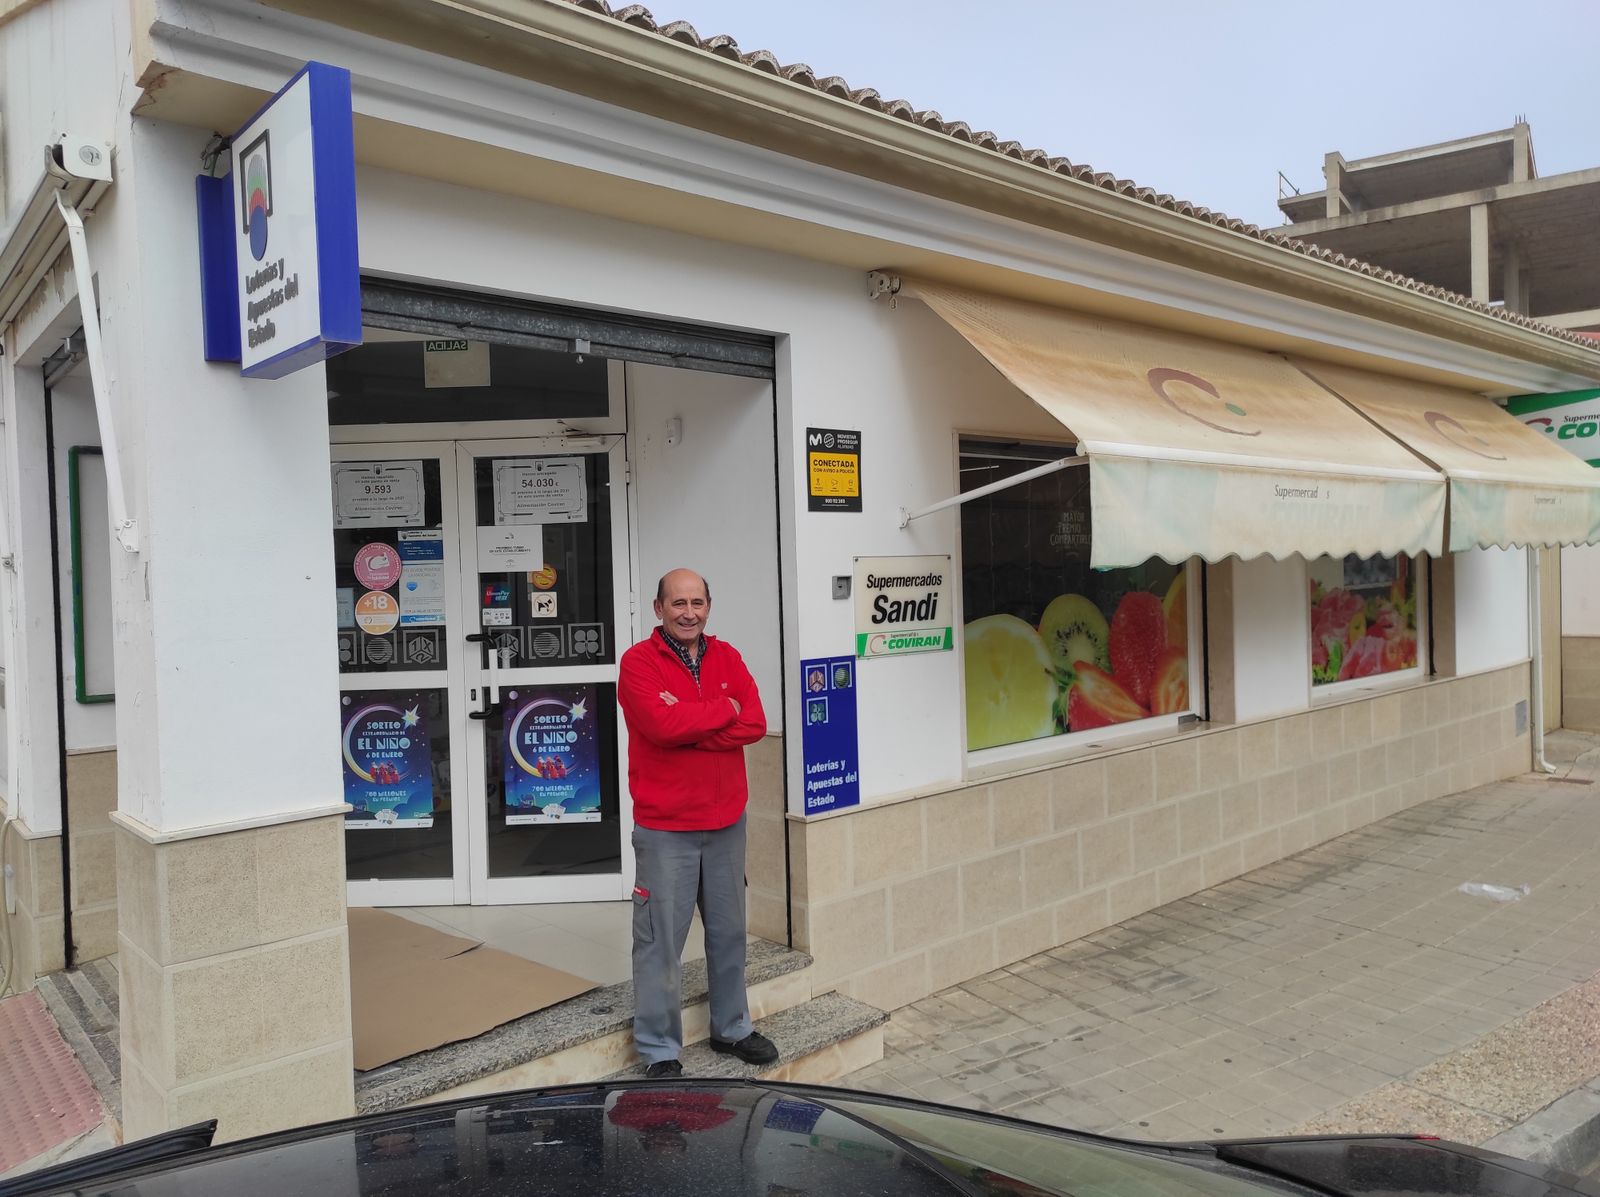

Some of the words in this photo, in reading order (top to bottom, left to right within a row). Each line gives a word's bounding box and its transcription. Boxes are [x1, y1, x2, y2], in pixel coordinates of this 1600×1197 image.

[1564, 414, 1600, 423] Superme
[1557, 422, 1600, 440] CO
[813, 459, 855, 468] CONECTADA
[364, 485, 392, 494] 9.593
[521, 478, 554, 488] 54.030
[866, 573, 943, 591] Supermercados
[364, 595, 388, 610] +18
[871, 592, 939, 625] Sandi
[888, 636, 942, 650] COVIRAN
[367, 721, 401, 730] SORTEO
[534, 715, 568, 724] SORTEO
[357, 738, 373, 750] EL
[376, 737, 411, 749] NIÑO
[524, 732, 540, 745] EL
[543, 731, 578, 744] NIÑO
[807, 759, 838, 775] Loterías
[840, 759, 846, 771] y
[807, 775, 844, 792] Apuestas
[845, 771, 857, 784] del
[807, 793, 835, 808] Estado
